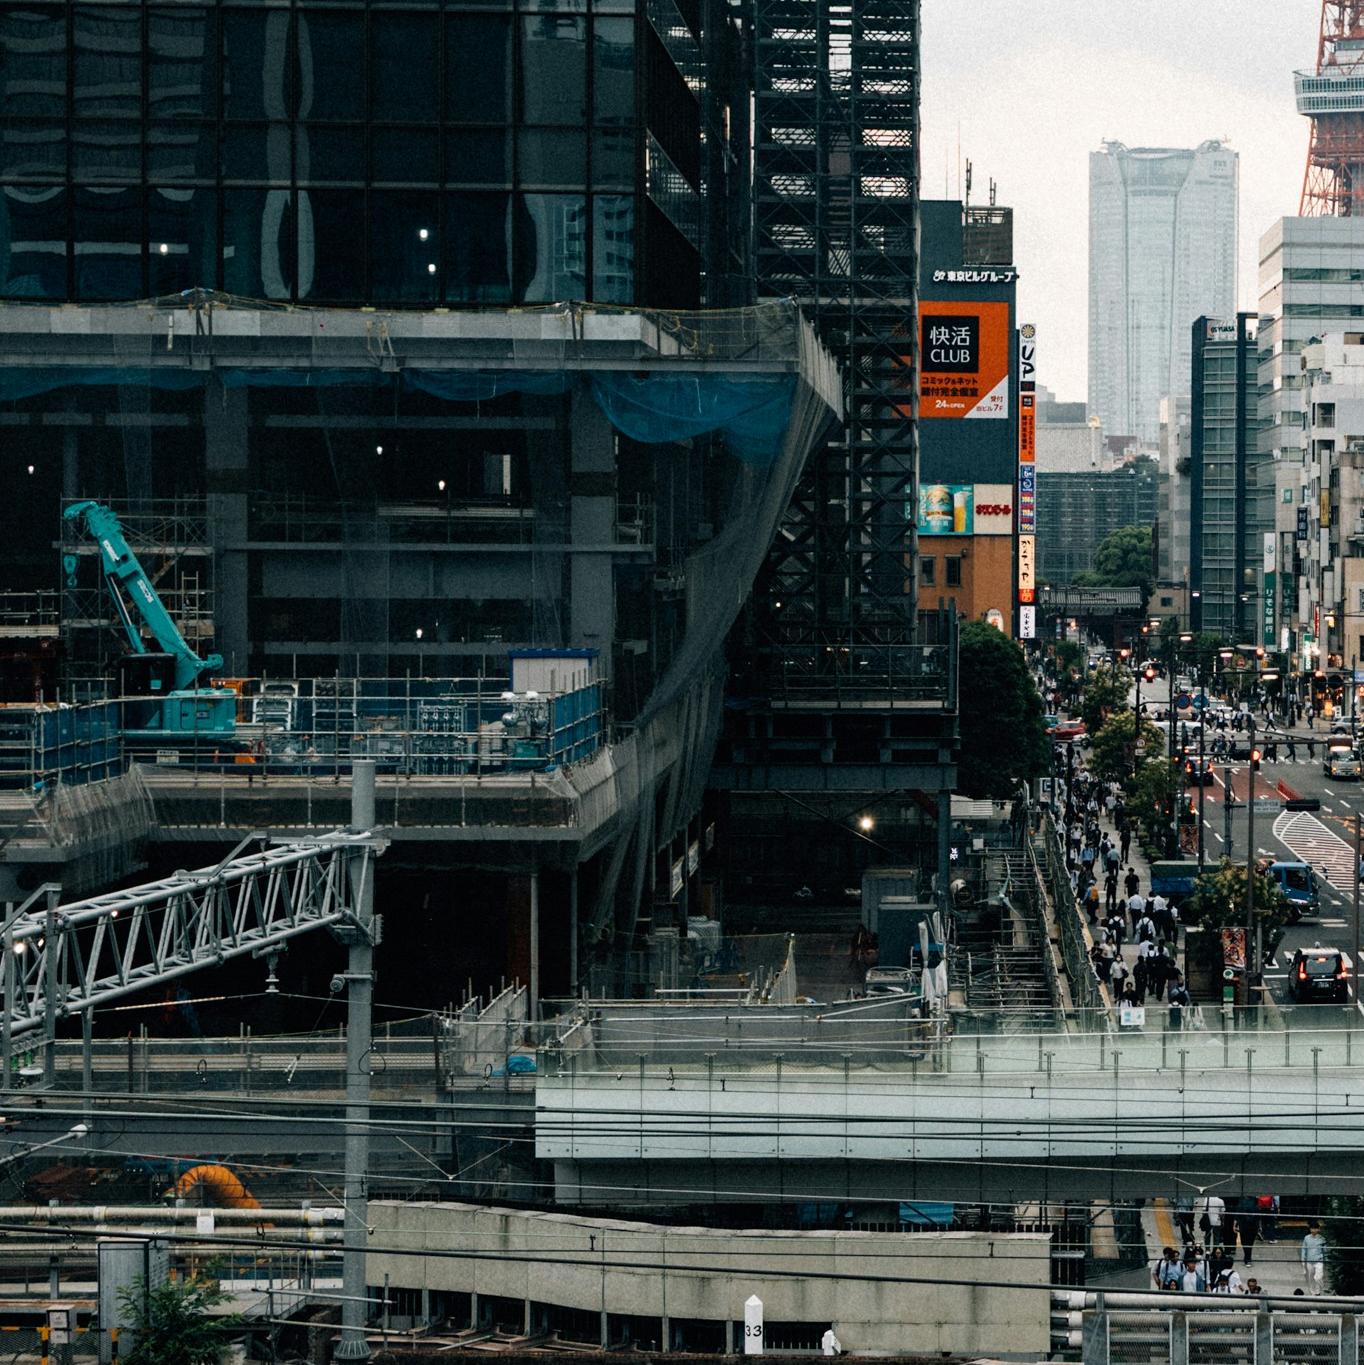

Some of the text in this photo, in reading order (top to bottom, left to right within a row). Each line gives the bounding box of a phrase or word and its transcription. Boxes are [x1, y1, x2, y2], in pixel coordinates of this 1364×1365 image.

[946, 271, 1015, 282] 東京ビルグループ
[930, 326, 971, 346] 快活
[930, 349, 971, 363] CLUB
[1021, 345, 1035, 379] UP
[1265, 590, 1274, 633] りそな銀行
